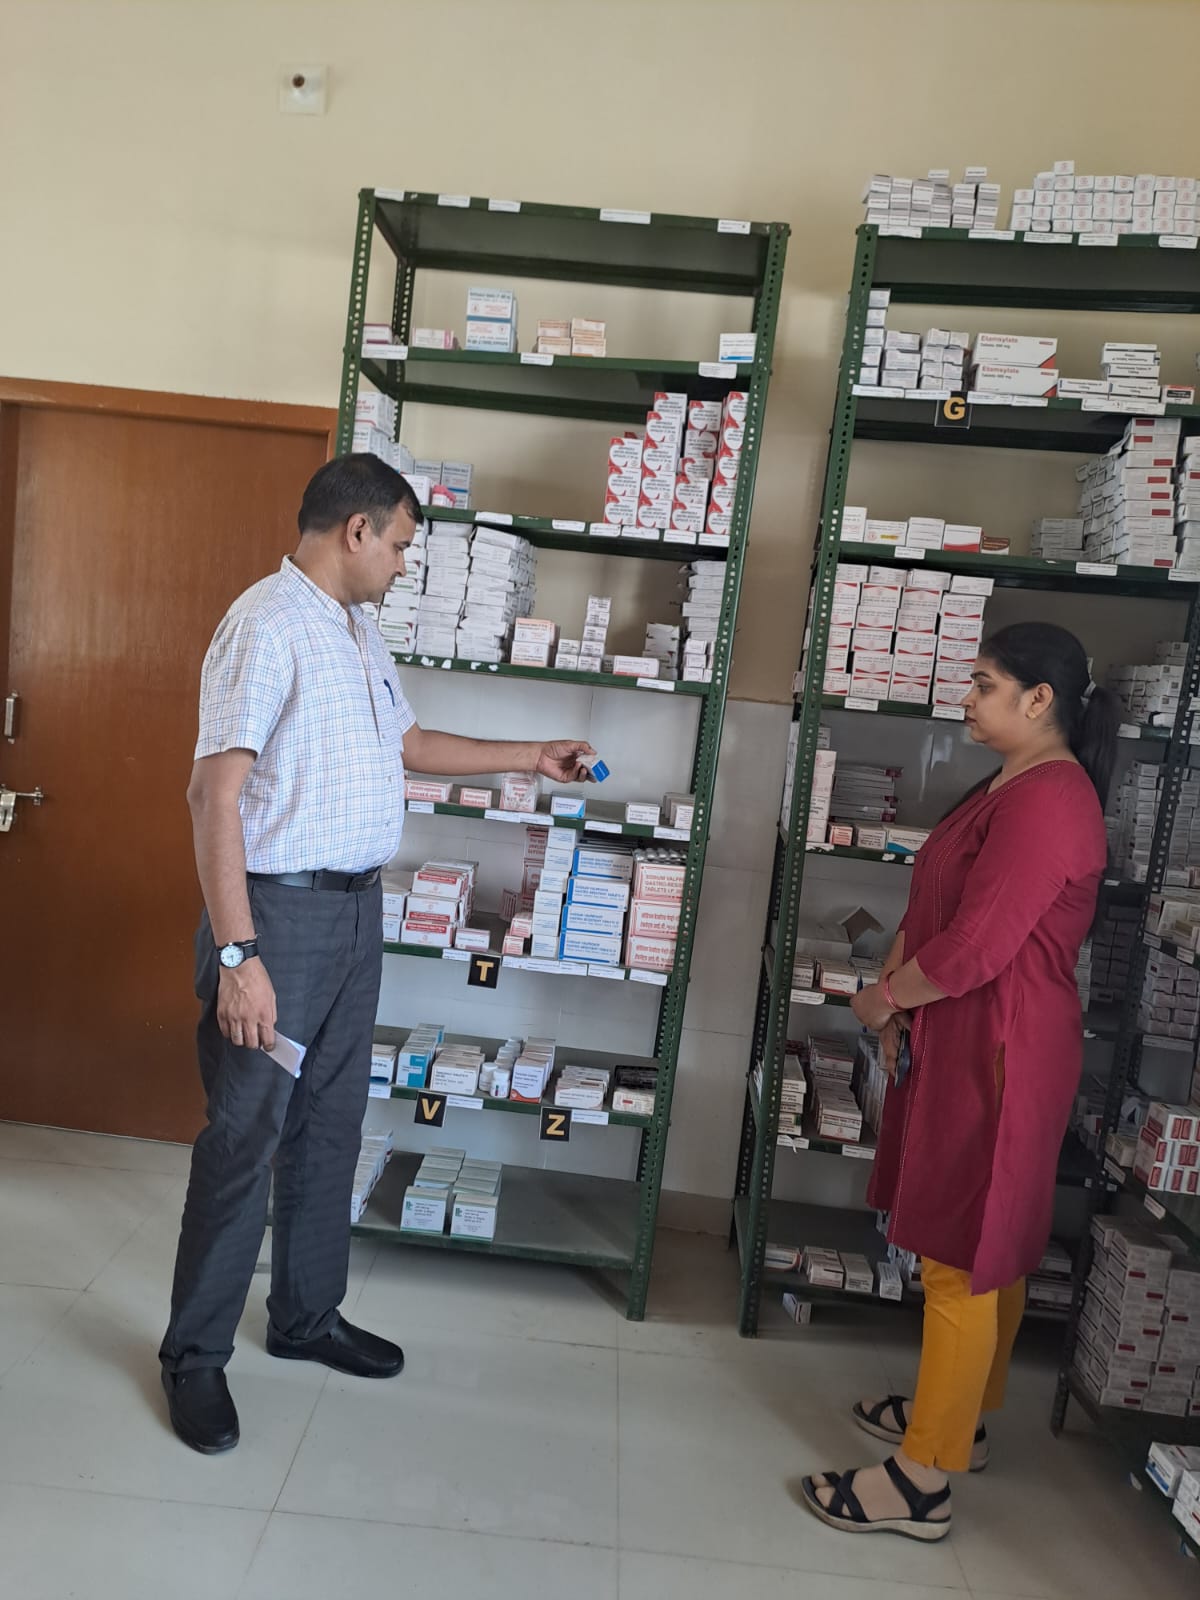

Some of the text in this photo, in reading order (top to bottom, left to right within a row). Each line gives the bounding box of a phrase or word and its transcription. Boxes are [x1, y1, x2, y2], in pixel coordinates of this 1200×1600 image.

[944, 397, 966, 420] G
[476, 960, 494, 982] T
[420, 1098, 441, 1121] V
[546, 1114, 565, 1136] Z
